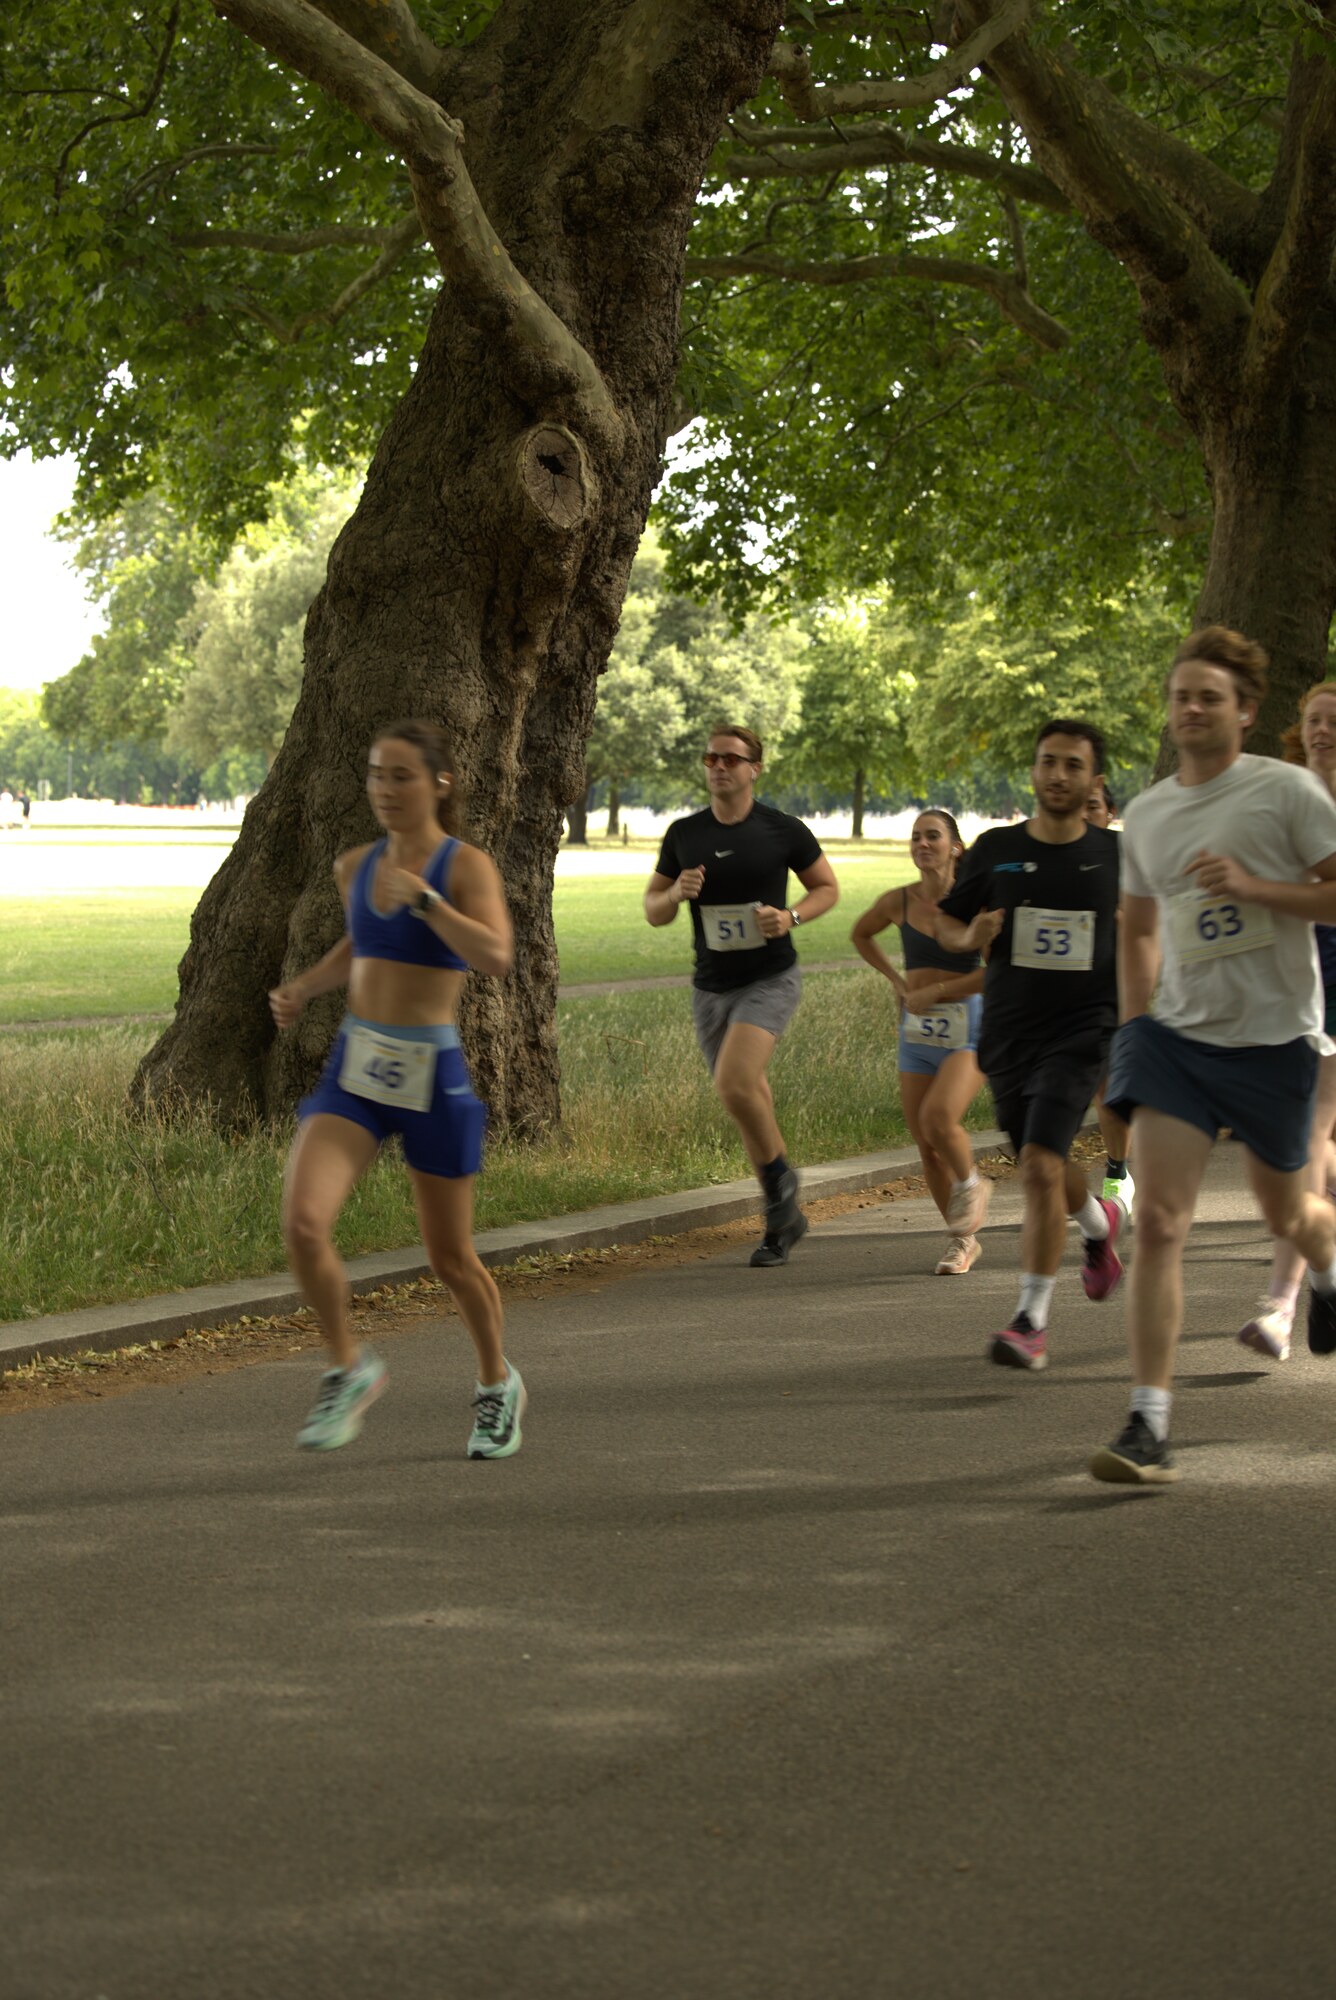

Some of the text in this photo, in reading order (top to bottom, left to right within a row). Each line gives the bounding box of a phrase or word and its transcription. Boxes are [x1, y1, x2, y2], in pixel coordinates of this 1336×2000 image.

[718, 919, 746, 940] 51
[1198, 903, 1244, 941] 63
[1034, 927, 1073, 956] 53
[920, 1018, 951, 1038] 52
